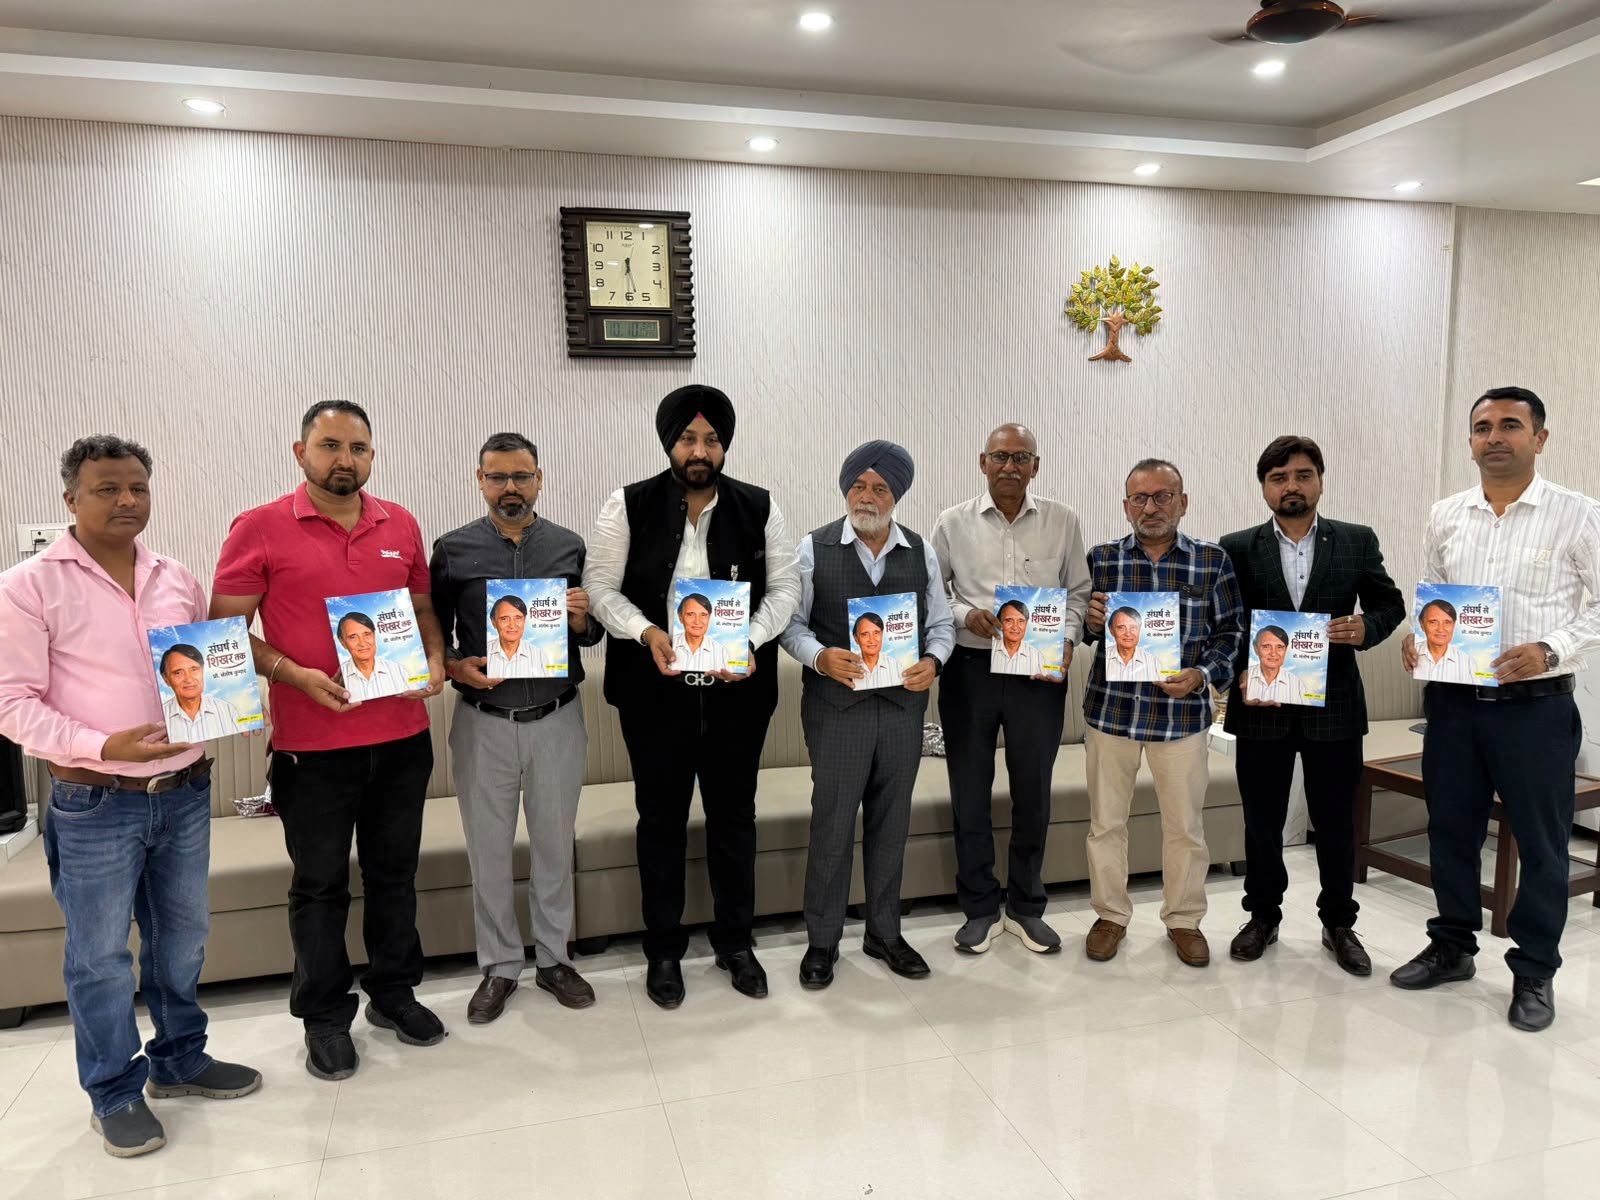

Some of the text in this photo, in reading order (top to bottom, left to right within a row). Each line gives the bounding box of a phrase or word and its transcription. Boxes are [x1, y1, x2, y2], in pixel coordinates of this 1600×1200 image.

[606, 231, 613, 240] 11
[620, 231, 633, 241] 12
[641, 231, 645, 240] 1
[592, 243, 604, 253] 10
[651, 245, 661, 255] 2
[594, 260, 604, 270] 9
[652, 262, 661, 272] 3
[595, 278, 605, 288] 8
[653, 280, 662, 289] 4
[609, 291, 616, 301] 7
[625, 291, 635, 302] 6
[641, 292, 651, 302] 5
[532, 597, 557, 607] संघर्ष से
[716, 598, 741, 608] संघर्ष से
[529, 607, 552, 619] शिखर
[714, 606, 735, 618] शिखर
[1034, 604, 1058, 614] संघर्ष से
[1147, 608, 1171, 618] संघर्ष से
[1462, 603, 1489, 614] संघर्ष से
[377, 608, 405, 622] संघर्ष से
[888, 611, 910, 622] संघर्ष से
[1031, 612, 1052, 623] शिखर
[1459, 612, 1483, 625] शिखर
[377, 619, 412, 634] शिखर तक
[886, 622, 905, 633] शिखर
[1294, 630, 1320, 640] संघर्ष से
[208, 639, 239, 655] संघर्ष से
[1291, 638, 1314, 650] शिखर
[207, 652, 246, 668] शिखर तक
